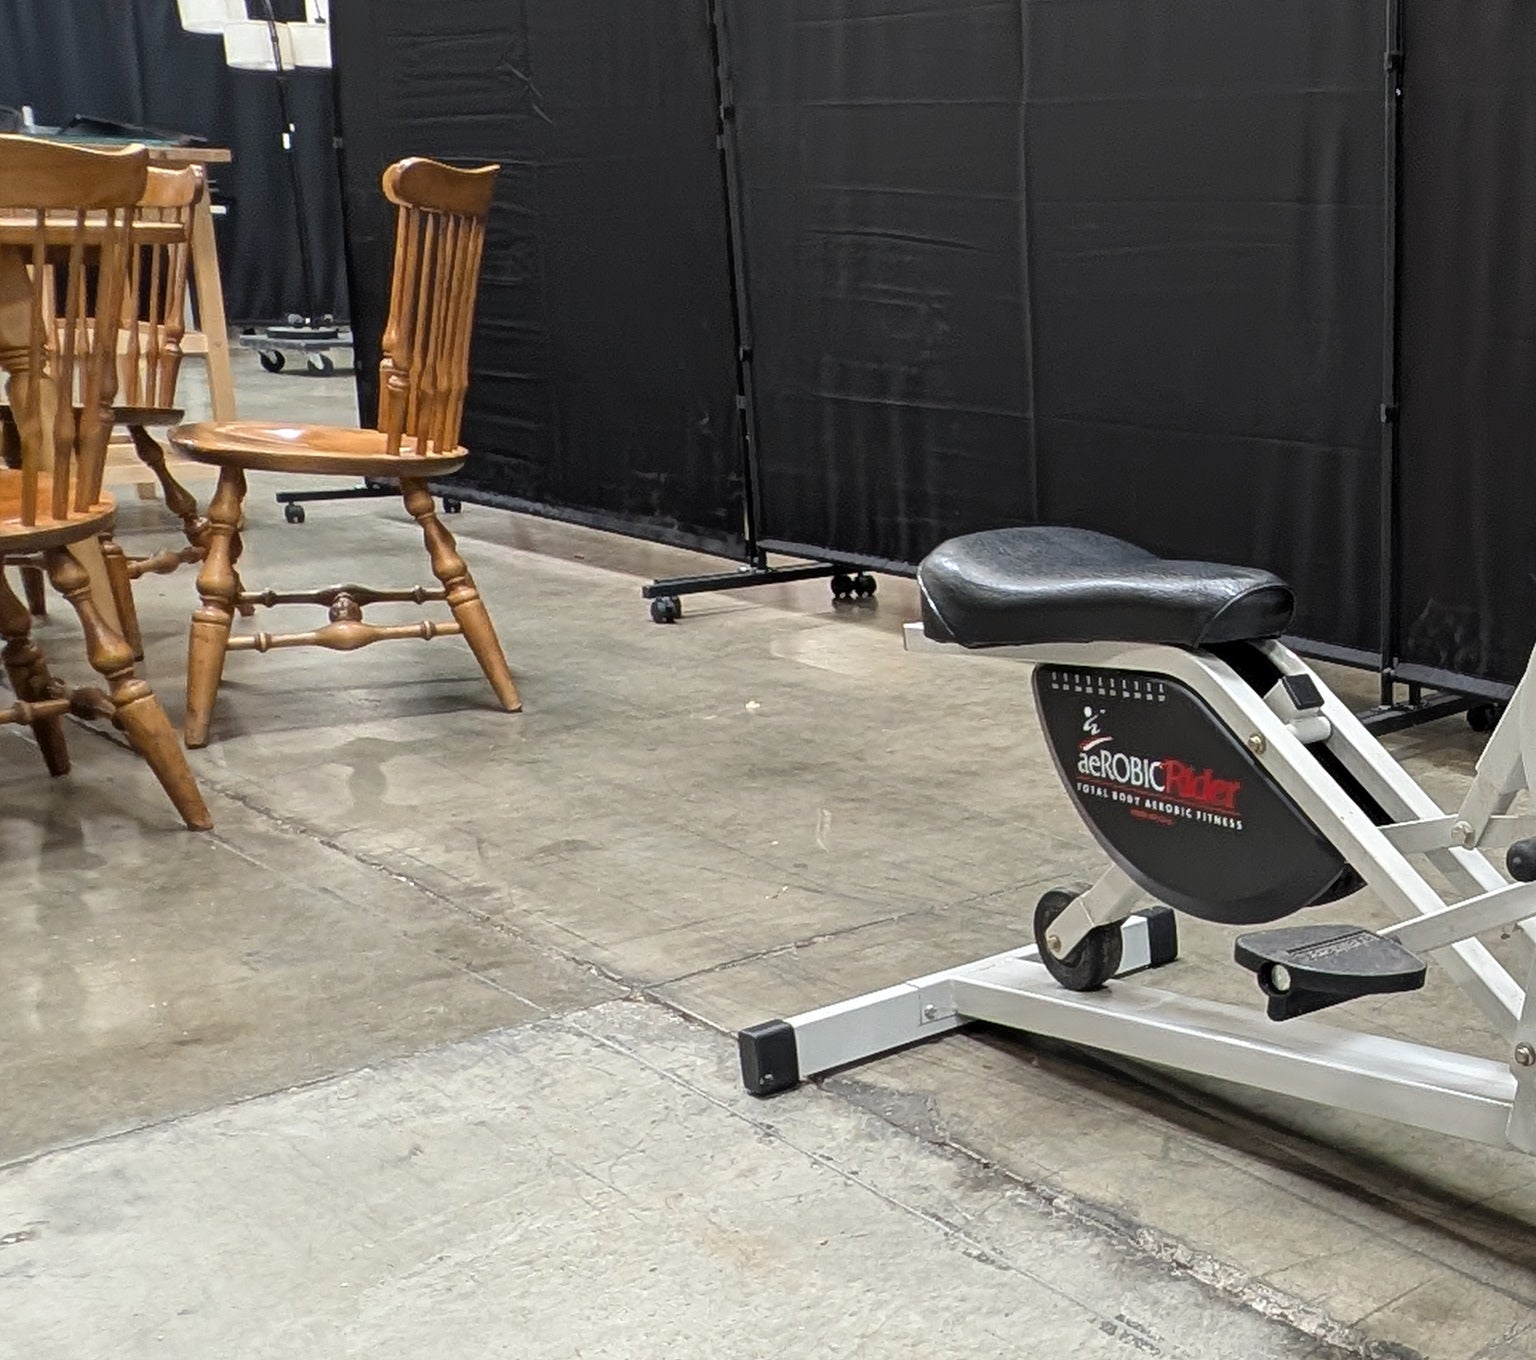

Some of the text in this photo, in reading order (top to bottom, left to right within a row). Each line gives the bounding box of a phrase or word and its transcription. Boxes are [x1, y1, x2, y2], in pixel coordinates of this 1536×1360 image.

[1076, 782, 1109, 798] TOTAL
[1144, 798, 1193, 819] AEROBIC
[1195, 811, 1243, 830] FITNESS
